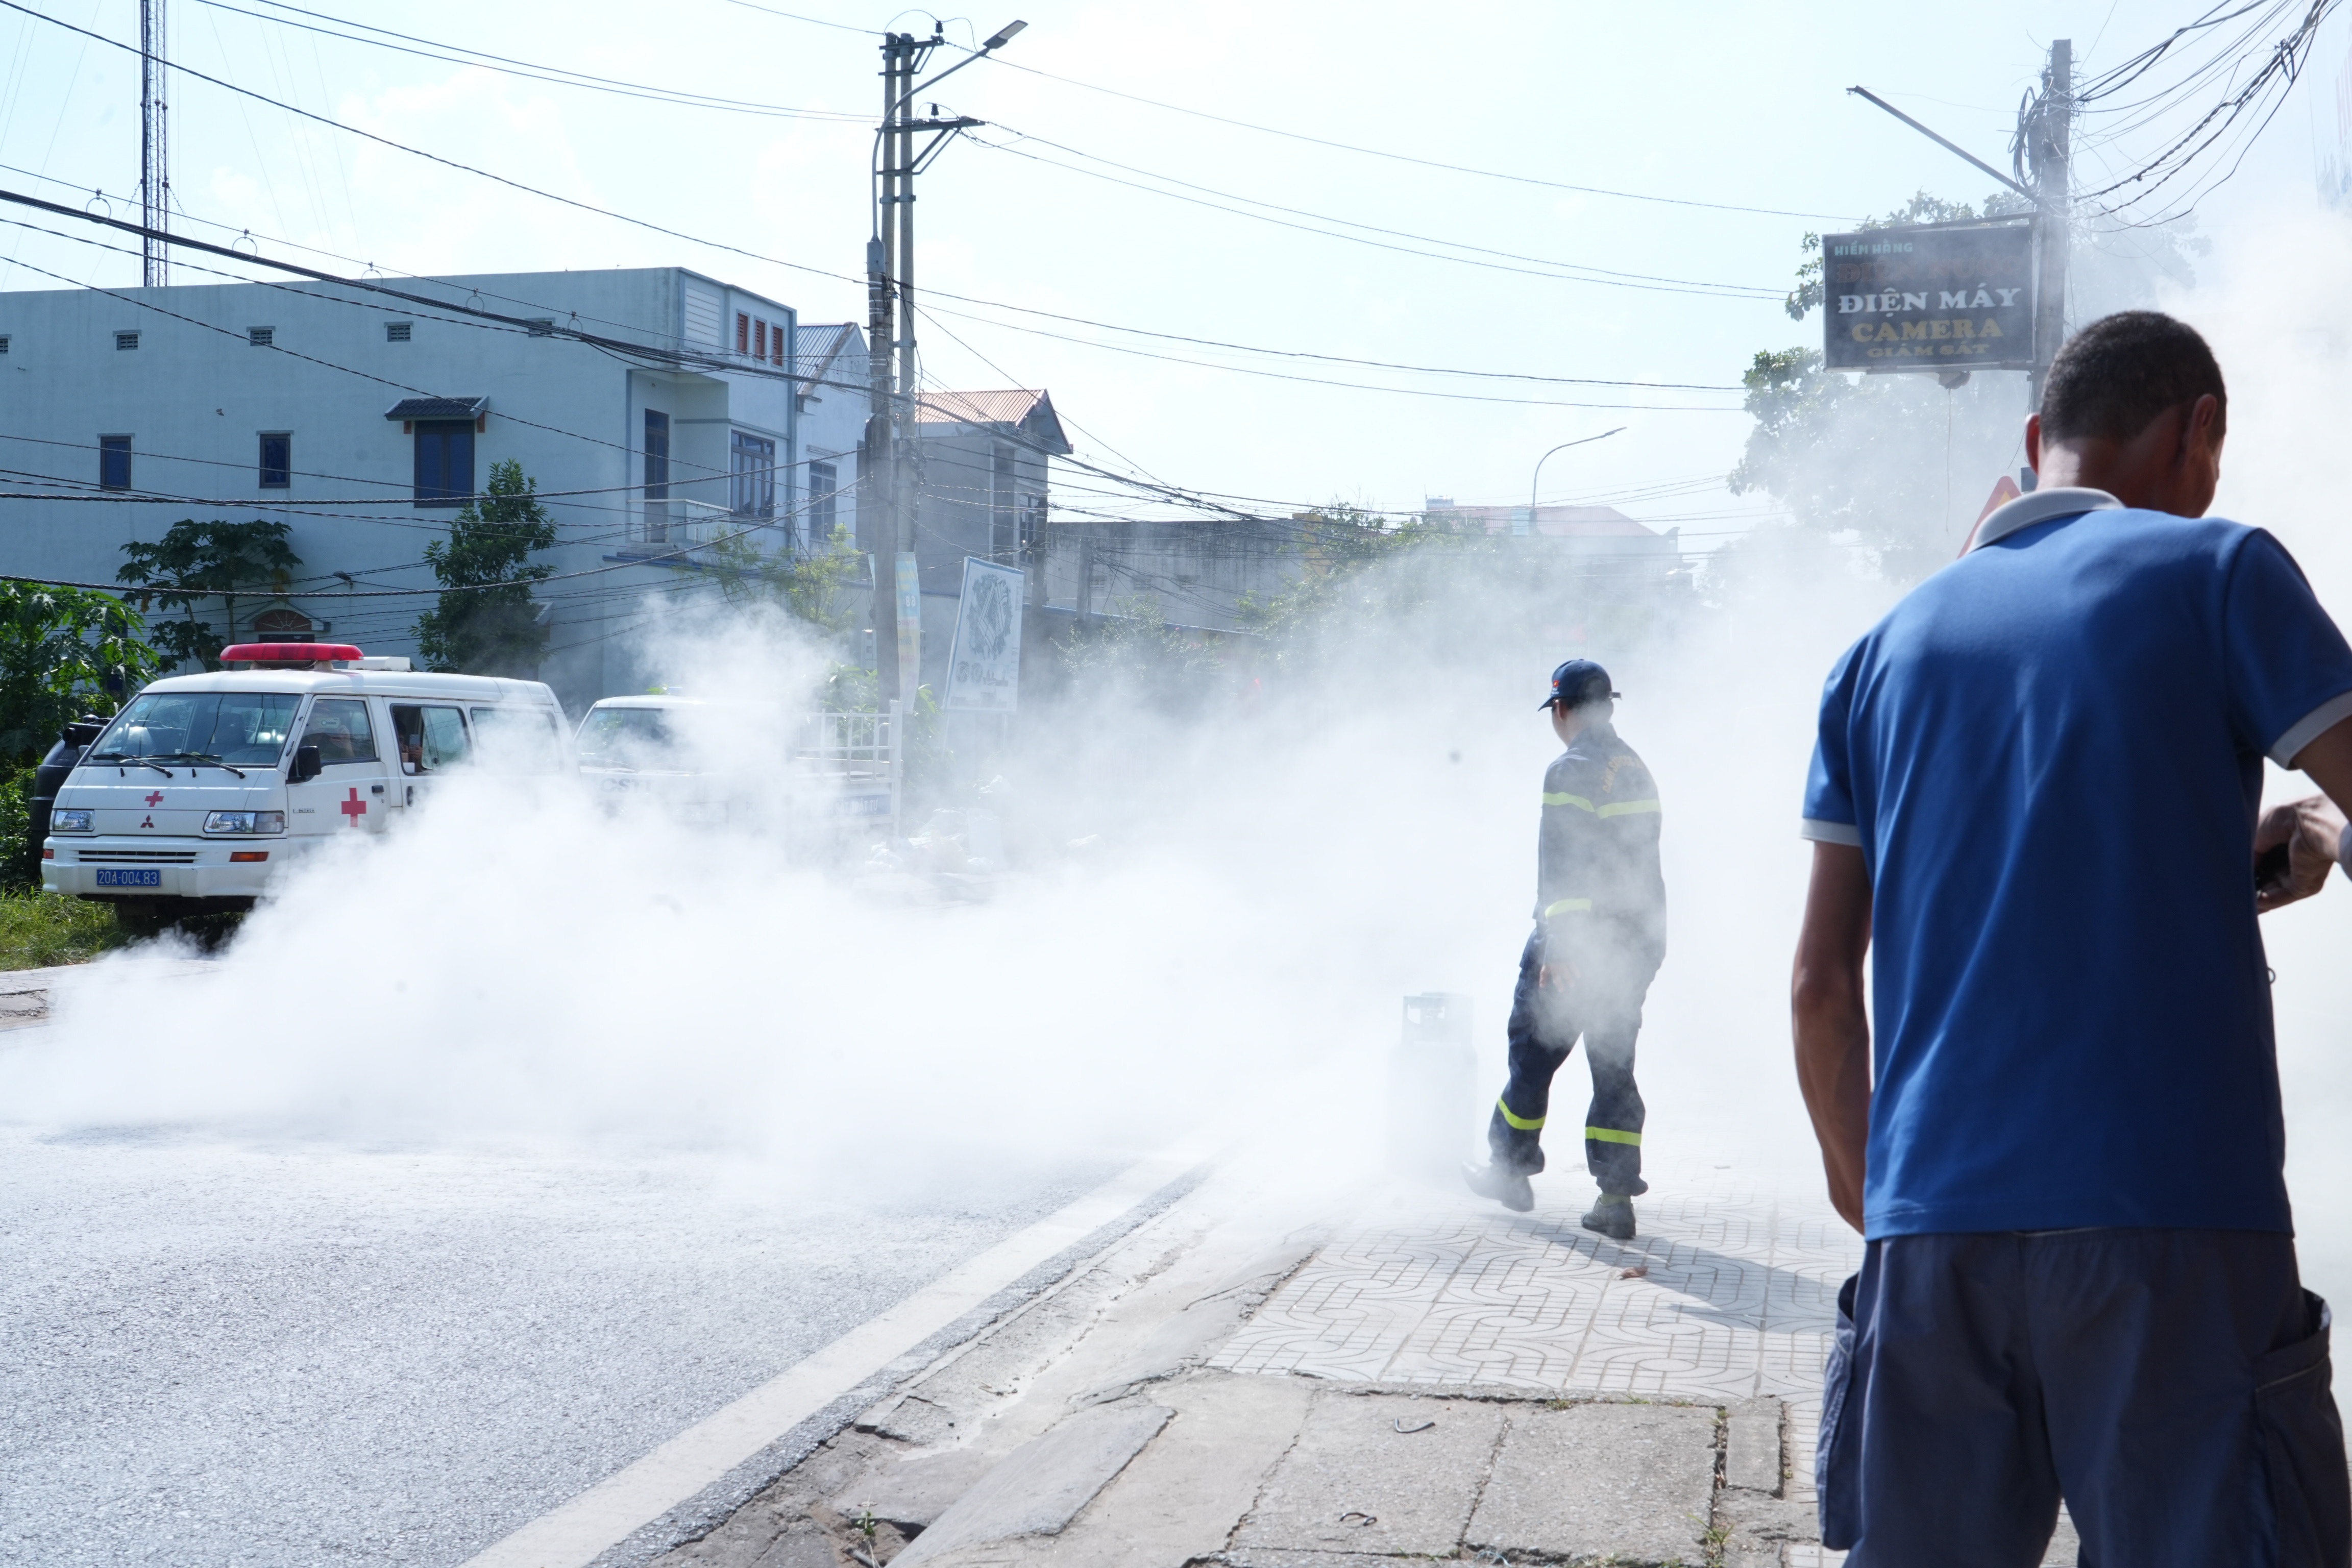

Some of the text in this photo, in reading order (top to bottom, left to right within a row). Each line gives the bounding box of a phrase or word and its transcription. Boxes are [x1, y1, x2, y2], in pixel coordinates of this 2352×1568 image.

[1838, 283, 2022, 317] ĐIỆN MÁY
[1851, 318, 2004, 342] CAMERA
[1867, 340, 1990, 357] GIÁM SÁT
[600, 777, 655, 793] CSTT
[99, 871, 157, 885] 20A-004.83
